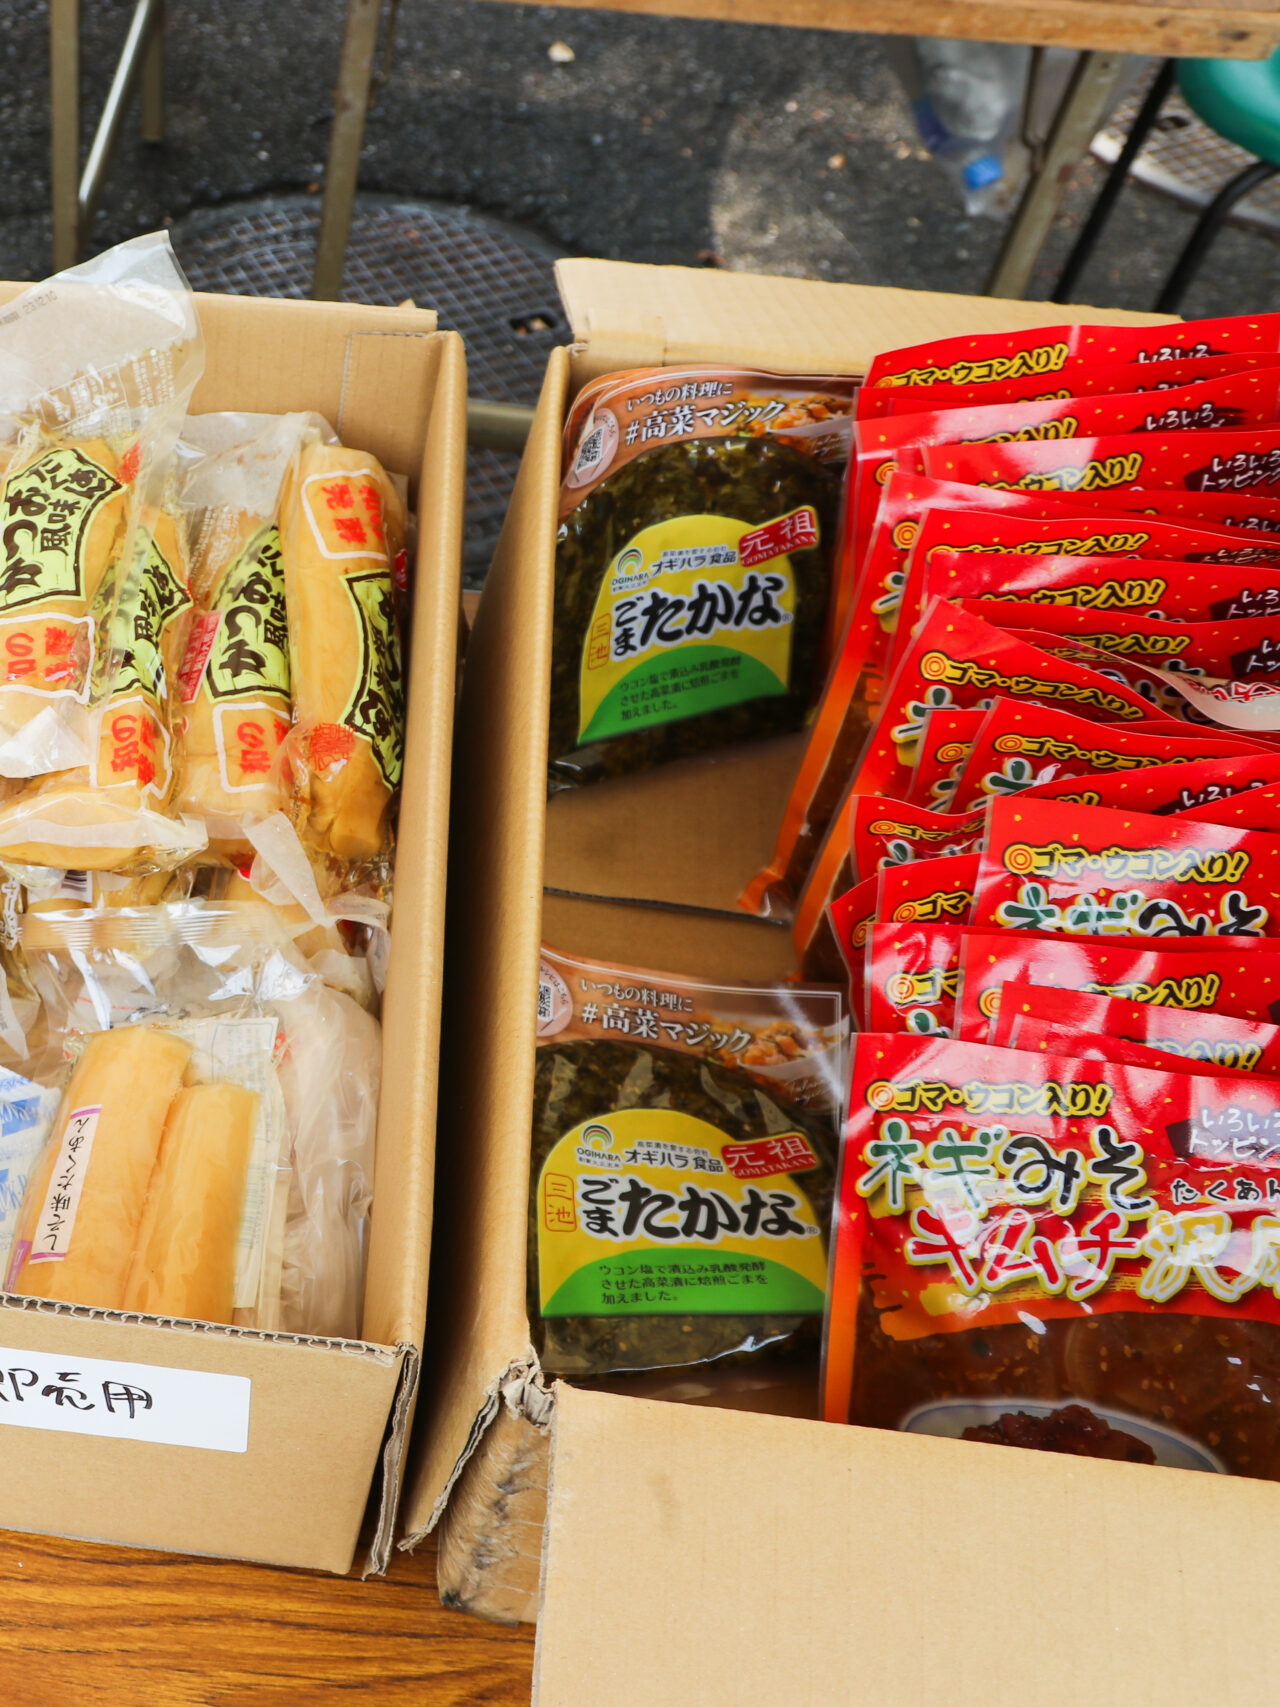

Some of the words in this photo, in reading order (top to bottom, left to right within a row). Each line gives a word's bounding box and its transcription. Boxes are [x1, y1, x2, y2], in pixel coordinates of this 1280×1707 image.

[626, 381, 733, 411] いつもの料理に
[1146, 403, 1215, 431] いろいろ
[625, 400, 786, 445] #高菜マジック
[1, 488, 51, 595] かつお
[40, 498, 82, 552] 風味
[740, 512, 816, 557] 元祖
[652, 551, 737, 577] オギハラ食品
[220, 576, 272, 676] かつお
[615, 596, 644, 656] ごま
[640, 575, 785, 647] たかな
[947, 660, 1146, 719] ゴマ・ウコン入り!
[110, 713, 140, 773] 和の
[236, 721, 271, 774] 和の
[1031, 843, 1251, 884] ゴマ・ウコン入り!
[580, 978, 694, 1013] いつもの料理に
[582, 1002, 753, 1052] #高菜マジック
[895, 1080, 1115, 1118] ゴマ・ウコン入り!
[577, 1147, 621, 1162] OGIHARA
[624, 1150, 724, 1173] オギハラ食品
[727, 1137, 811, 1168] 元祖
[732, 1158, 817, 1178] GOMATAKANA
[858, 1117, 1157, 1218] ネギみそ
[45, 1117, 91, 1252] しそ味たくあん
[547, 1181, 575, 1224] 三池
[582, 1178, 619, 1237] ごま
[619, 1179, 806, 1241] たかな
[601, 1290, 679, 1305] 加えました。
